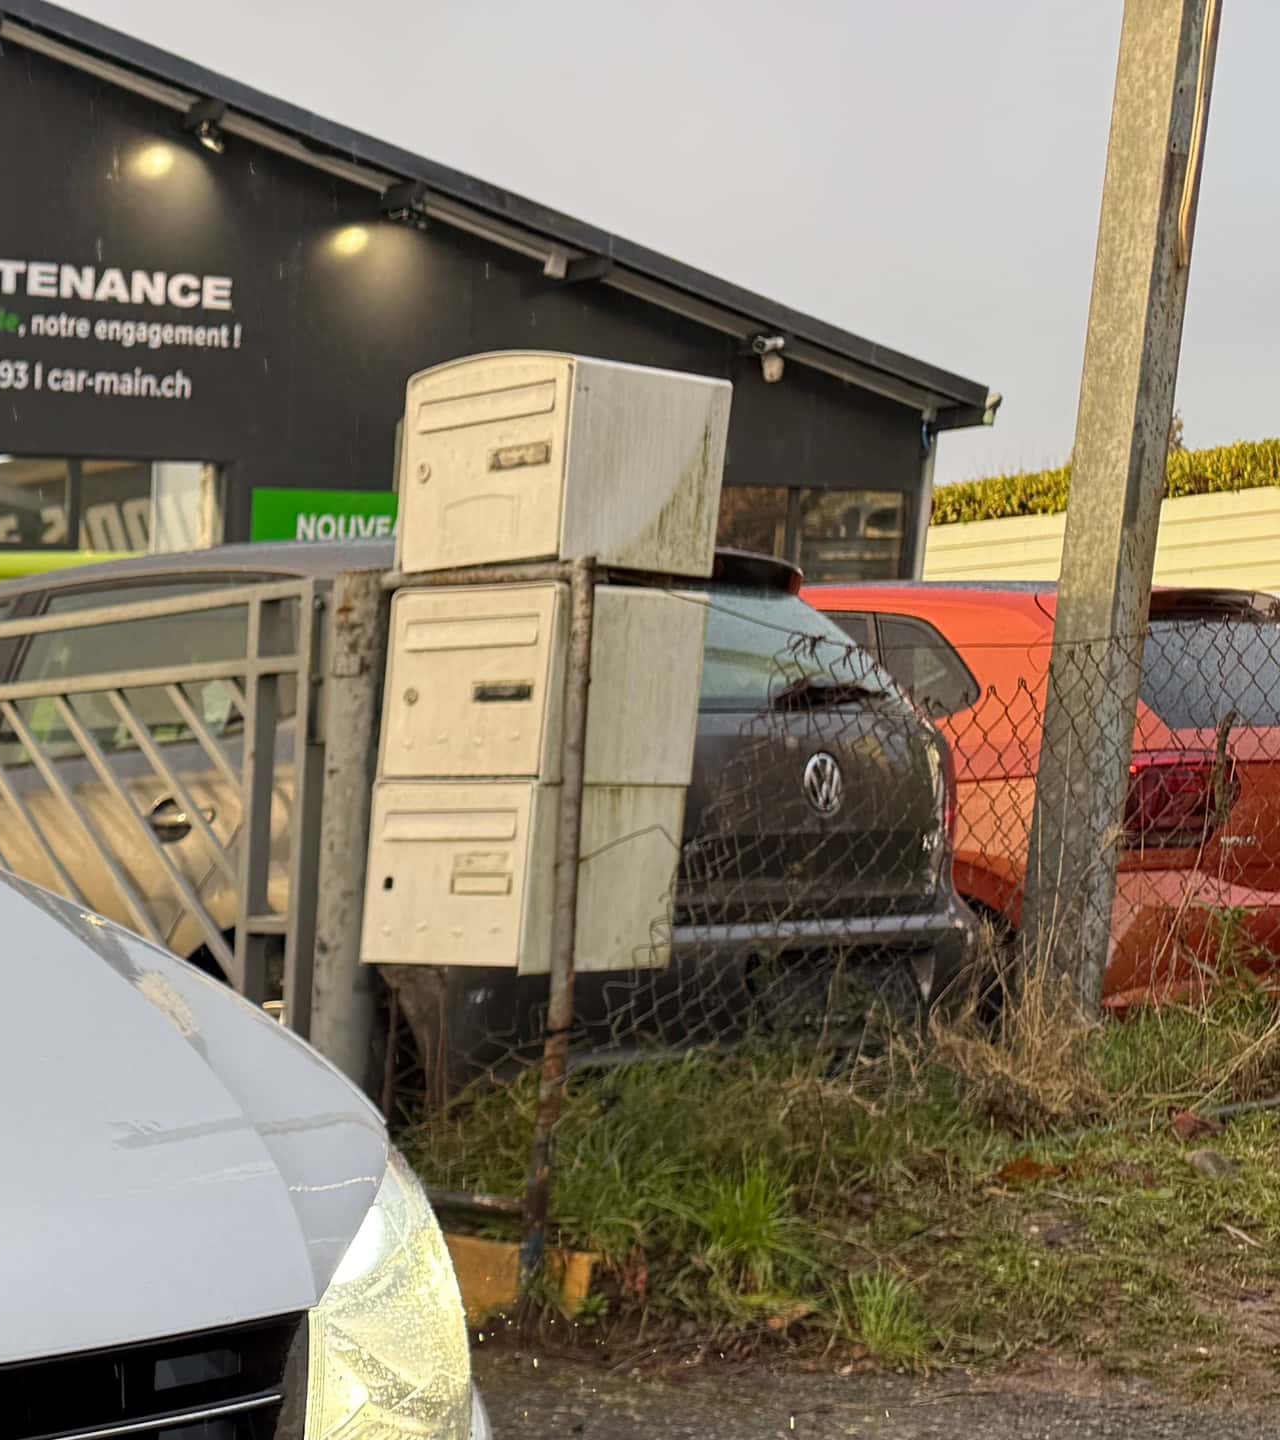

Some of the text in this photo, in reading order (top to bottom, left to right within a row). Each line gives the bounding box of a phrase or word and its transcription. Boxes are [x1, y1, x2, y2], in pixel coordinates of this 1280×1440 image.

[31, 312, 91, 338] notre
[94, 319, 229, 349] engagement
[47, 366, 192, 400] car-main.ch
